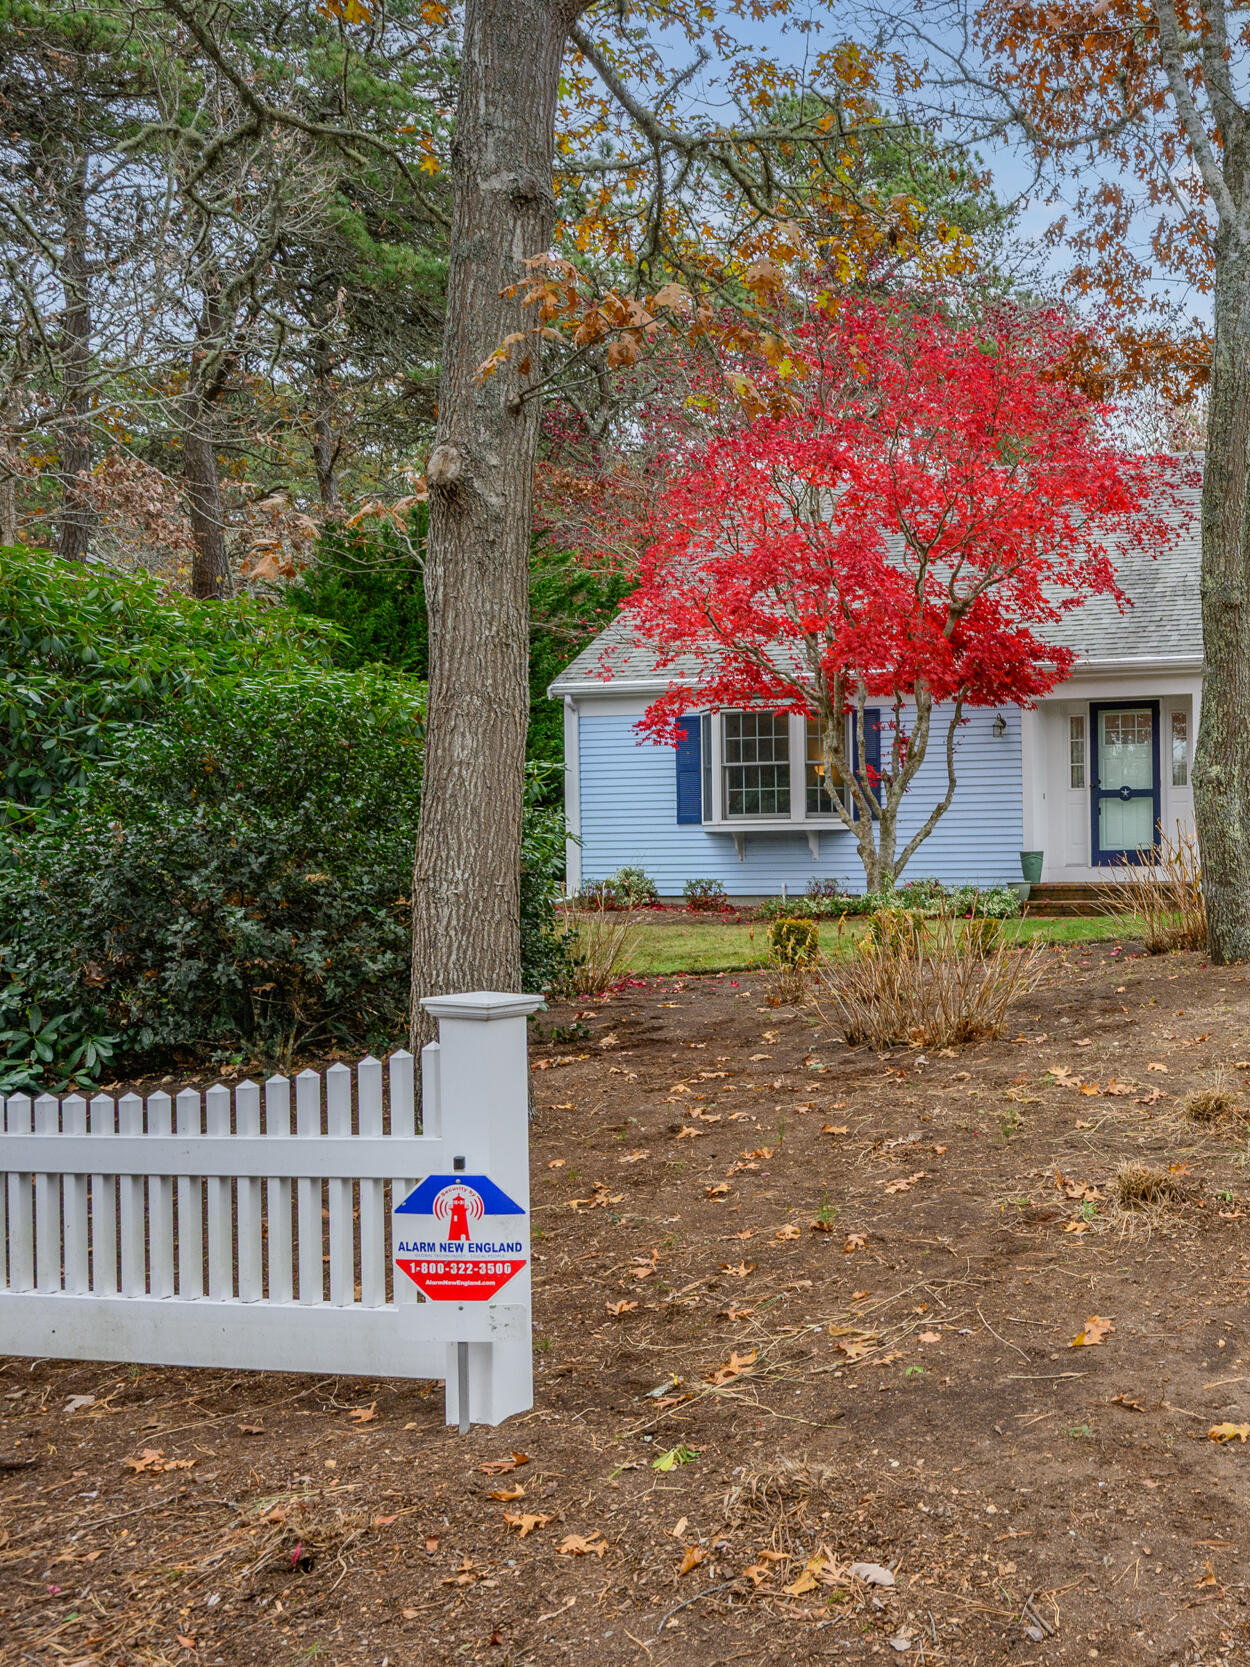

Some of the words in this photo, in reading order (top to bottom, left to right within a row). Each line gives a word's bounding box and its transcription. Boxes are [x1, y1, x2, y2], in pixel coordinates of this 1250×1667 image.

[441, 1186, 467, 1196] Security
[398, 1241, 436, 1252] ALARM
[439, 1242, 465, 1253] NEW
[468, 1242, 523, 1253] ENGLAND
[410, 1262, 512, 1274] 1-800-322-3500
